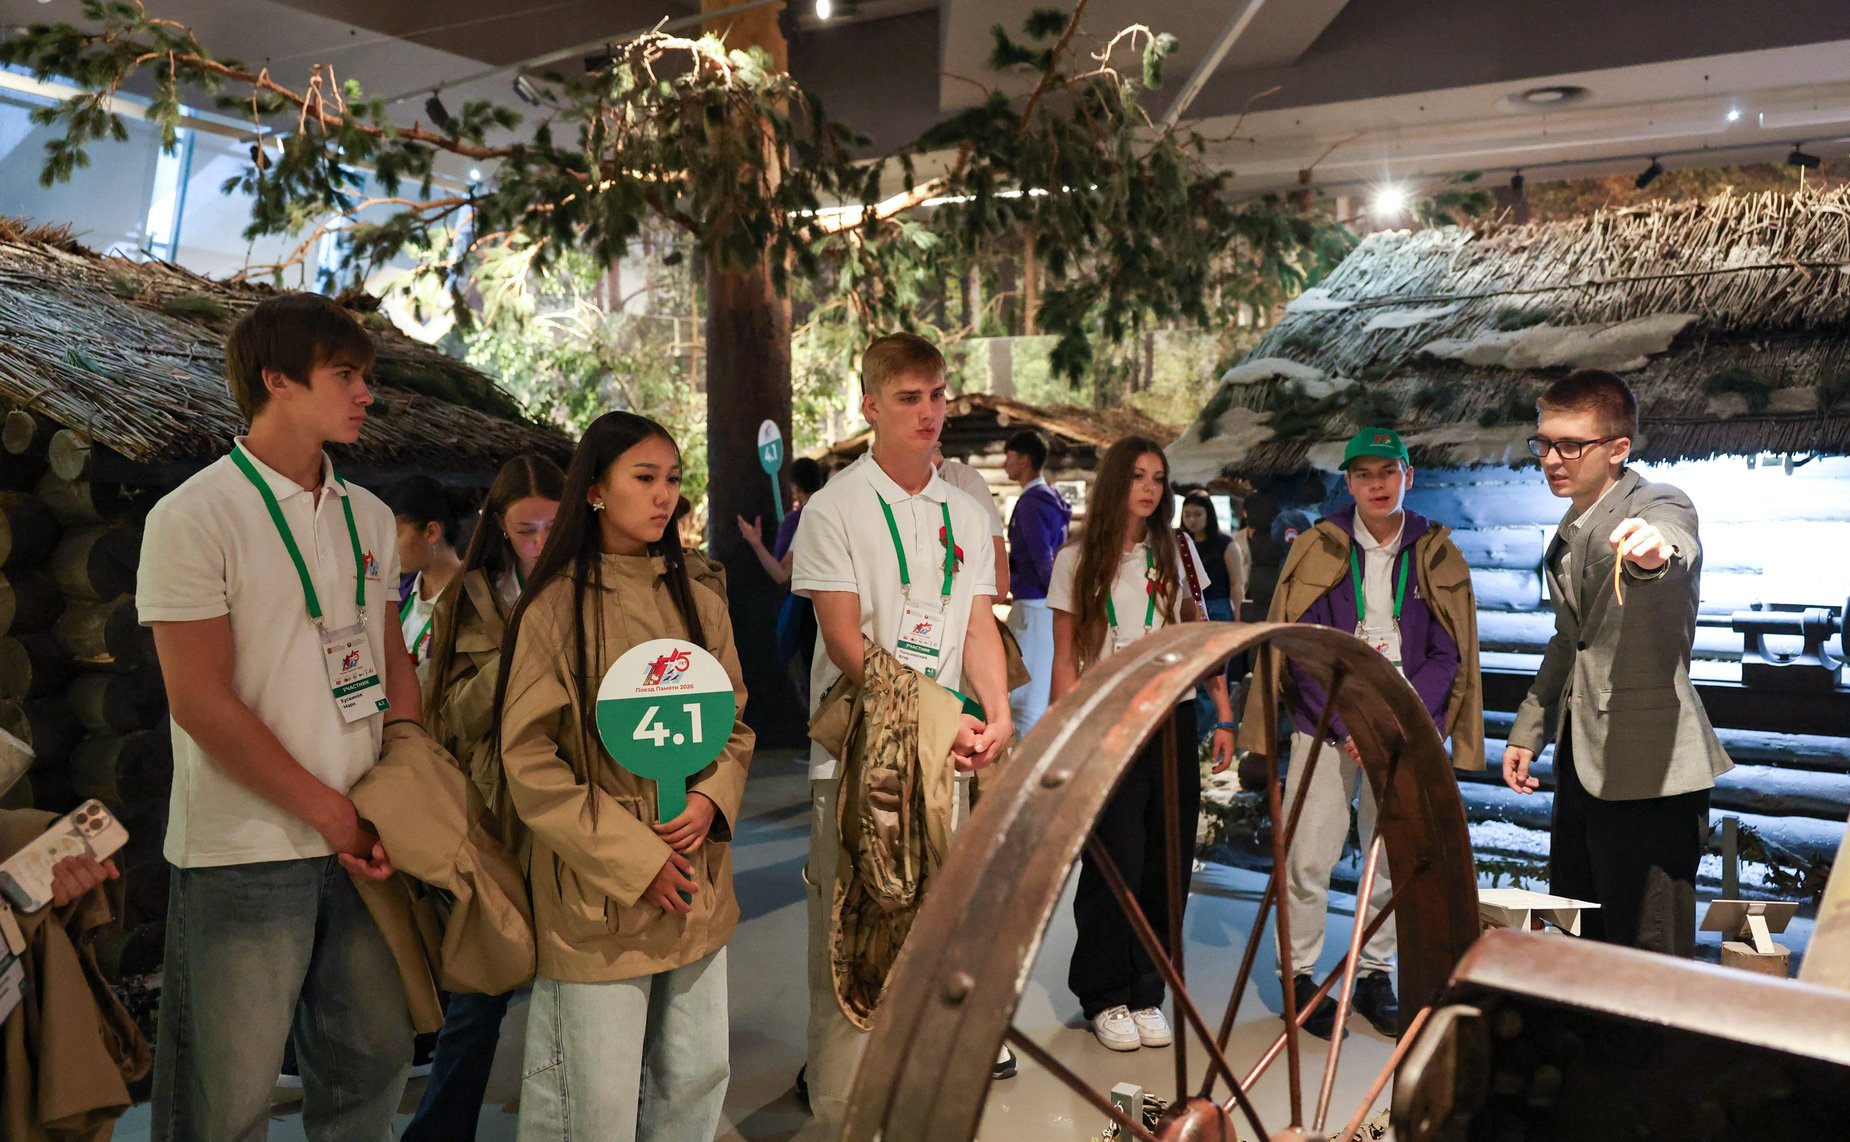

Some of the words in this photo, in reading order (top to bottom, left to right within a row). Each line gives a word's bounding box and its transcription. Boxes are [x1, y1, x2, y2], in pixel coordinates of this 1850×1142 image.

[764, 444, 778, 463] 4.1
[907, 643, 931, 653] УЧАСТНИК
[342, 680, 370, 693] УЧАСТНИК
[655, 684, 679, 692] Памяти
[632, 702, 703, 747] 4.1
